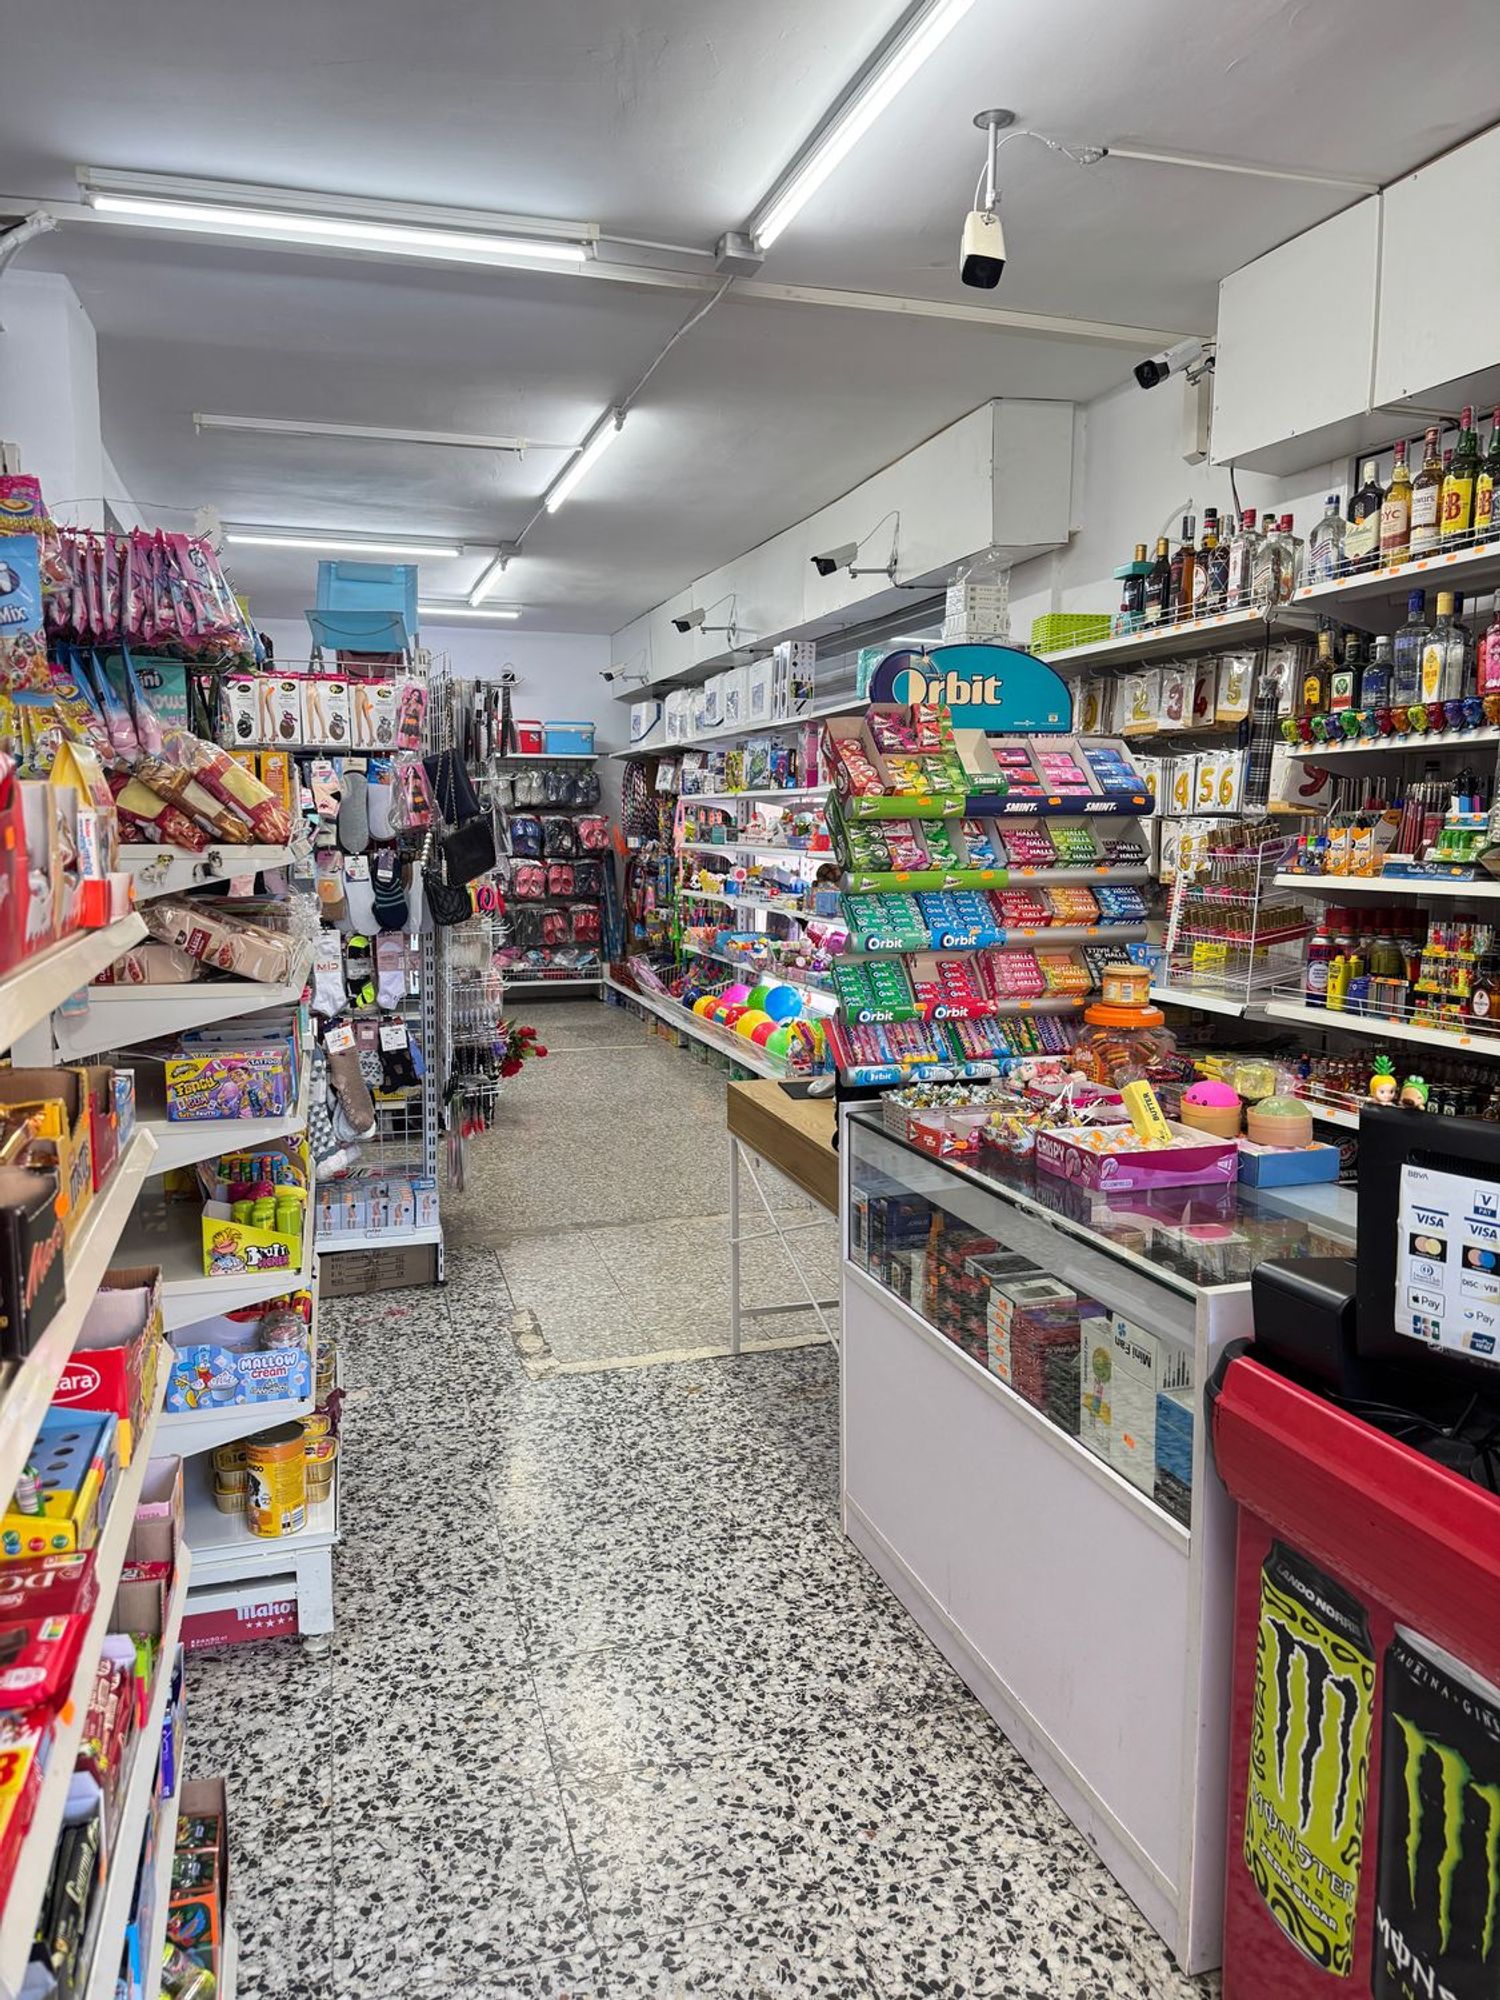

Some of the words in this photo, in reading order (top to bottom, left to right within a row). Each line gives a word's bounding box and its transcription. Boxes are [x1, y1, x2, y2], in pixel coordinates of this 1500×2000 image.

[892, 670, 1003, 705] Orbit
[974, 776, 1001, 785] SMINT
[1199, 767, 1215, 803] 5
[1219, 767, 1235, 806] 6
[1004, 802, 1036, 812] SMINT
[1084, 802, 1116, 812] SMINT
[868, 934, 903, 950] Orbit
[943, 932, 976, 948] Orbit
[858, 1010, 894, 1023] Orbit
[934, 1006, 969, 1020] Orbit
[1142, 1091, 1160, 1121] BUTTER
[1037, 1135, 1065, 1162] CRISPY
[1408, 1169, 1429, 1180] BBVA
[1481, 1194, 1492, 1206] V
[1416, 1212, 1445, 1229] VISA
[1470, 1223, 1498, 1240] VISA
[1421, 1295, 1441, 1311] Pay
[1476, 1310, 1495, 1327] Pay
[1114, 1335, 1132, 1356] Fan
[239, 1353, 298, 1372] MALLOW
[1132, 1347, 1152, 1368] Mini
[251, 1367, 287, 1379] cream
[57, 1374, 93, 1391] ara
[1276, 1562, 1316, 1602] LANDO
[1259, 1839, 1293, 1888] ZERO
[1292, 1883, 1339, 1934] SUGAR
